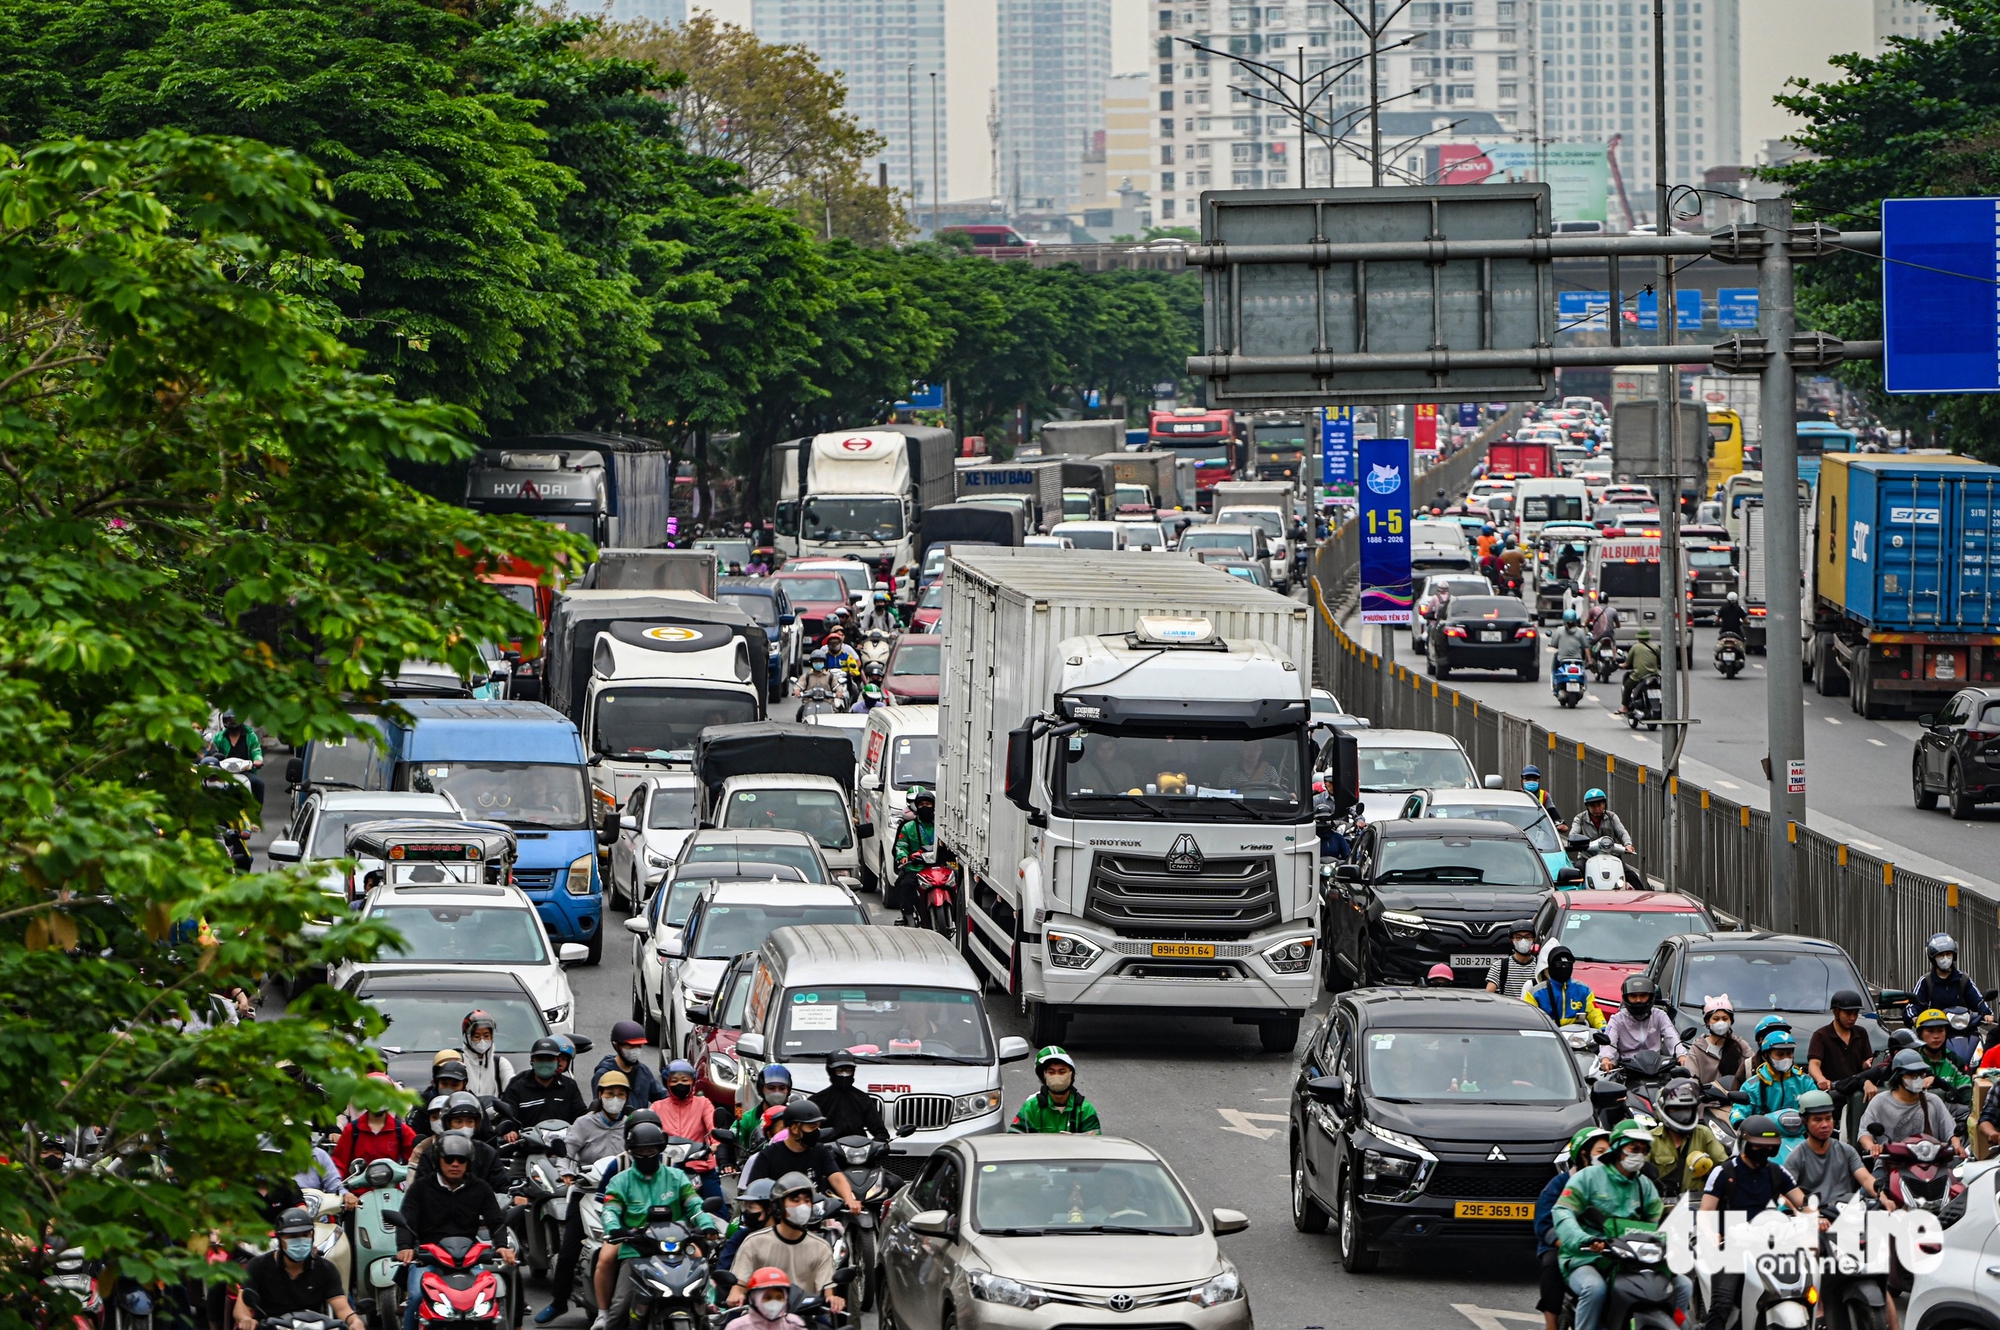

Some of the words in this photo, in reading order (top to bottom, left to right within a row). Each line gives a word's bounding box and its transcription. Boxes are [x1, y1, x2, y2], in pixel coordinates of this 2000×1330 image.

[965, 472, 980, 486] XE
[1893, 511, 1938, 520] SITC
[1366, 509, 1403, 534] 1-5
[1089, 838, 1142, 848] SINOTRUK
[1157, 945, 1210, 956] 89H-091.64
[867, 1083, 911, 1093] SRM
[1461, 1204, 1529, 1217] 29E-369.19
